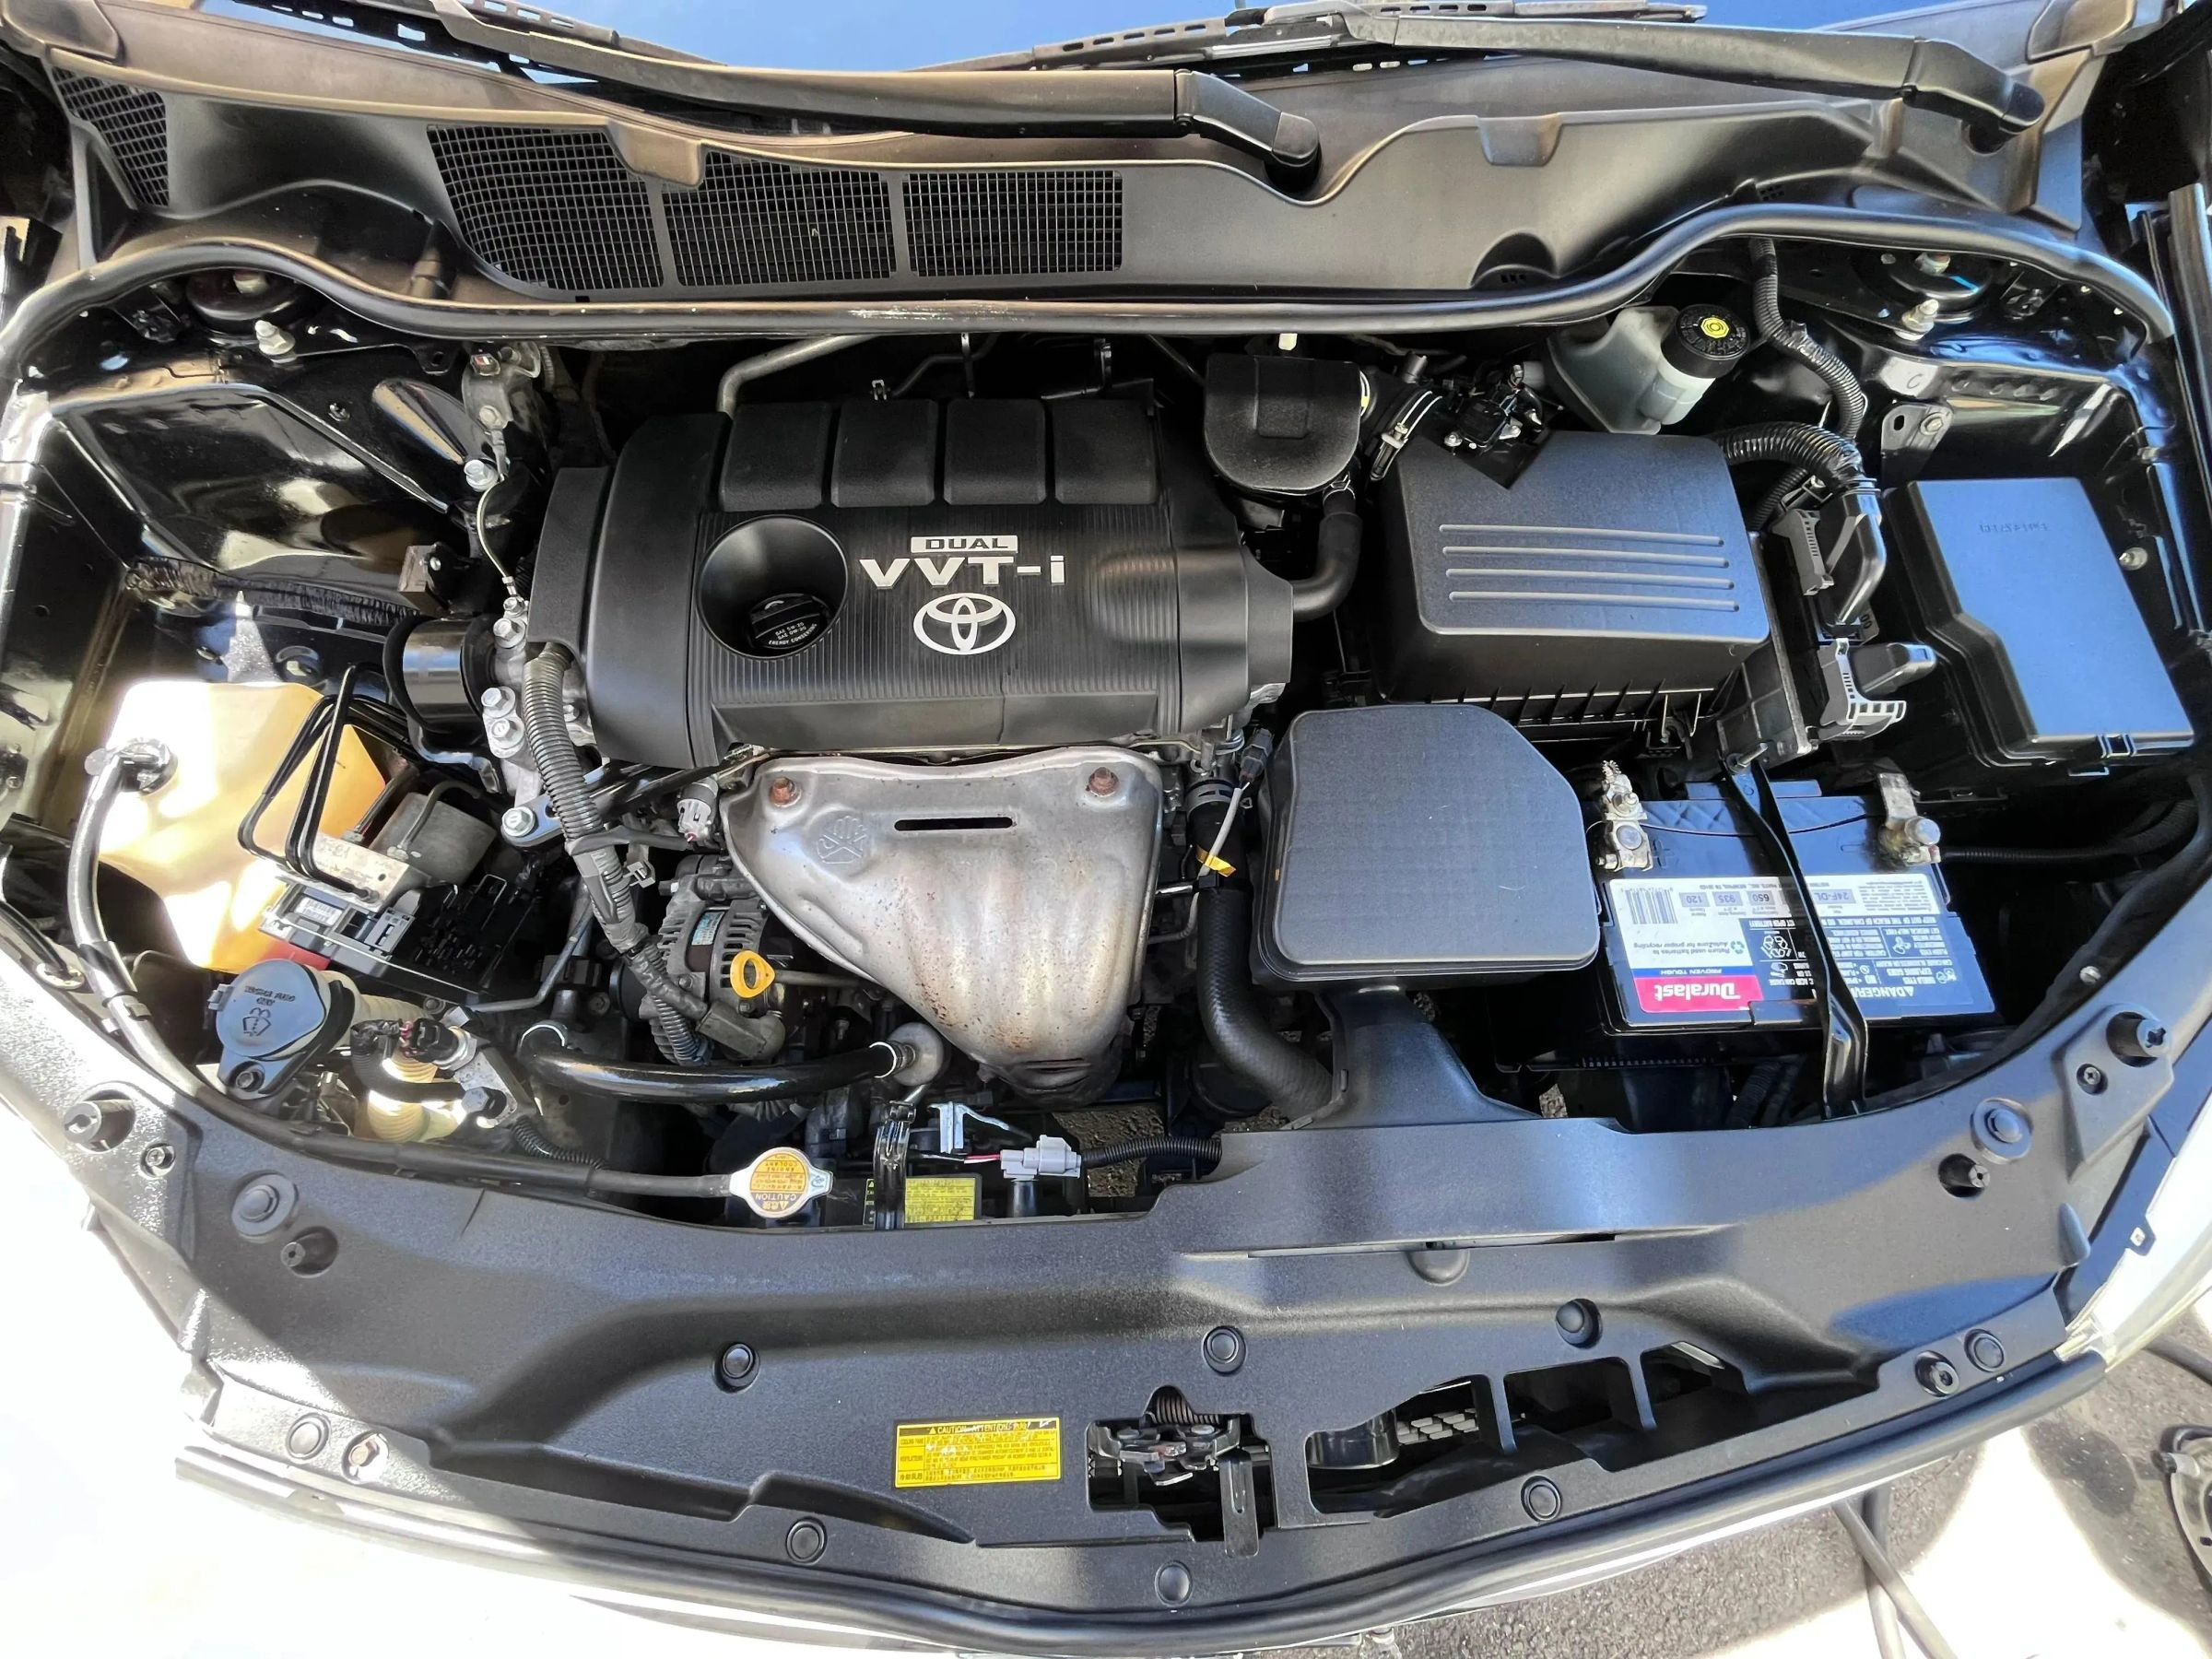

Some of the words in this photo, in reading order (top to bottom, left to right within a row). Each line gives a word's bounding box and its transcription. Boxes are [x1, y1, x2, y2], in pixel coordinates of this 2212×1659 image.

[926, 538, 1008, 549] DUAL
[859, 556, 1065, 589] VVT-i
[1687, 895, 1702, 903] 120
[1718, 895, 1735, 903] 935
[1814, 892, 1849, 901] 24F-DL
[1654, 982, 1740, 1001] Duralast
[755, 1193, 797, 1201] CAUTION
[937, 1425, 967, 1434] CAUTION
